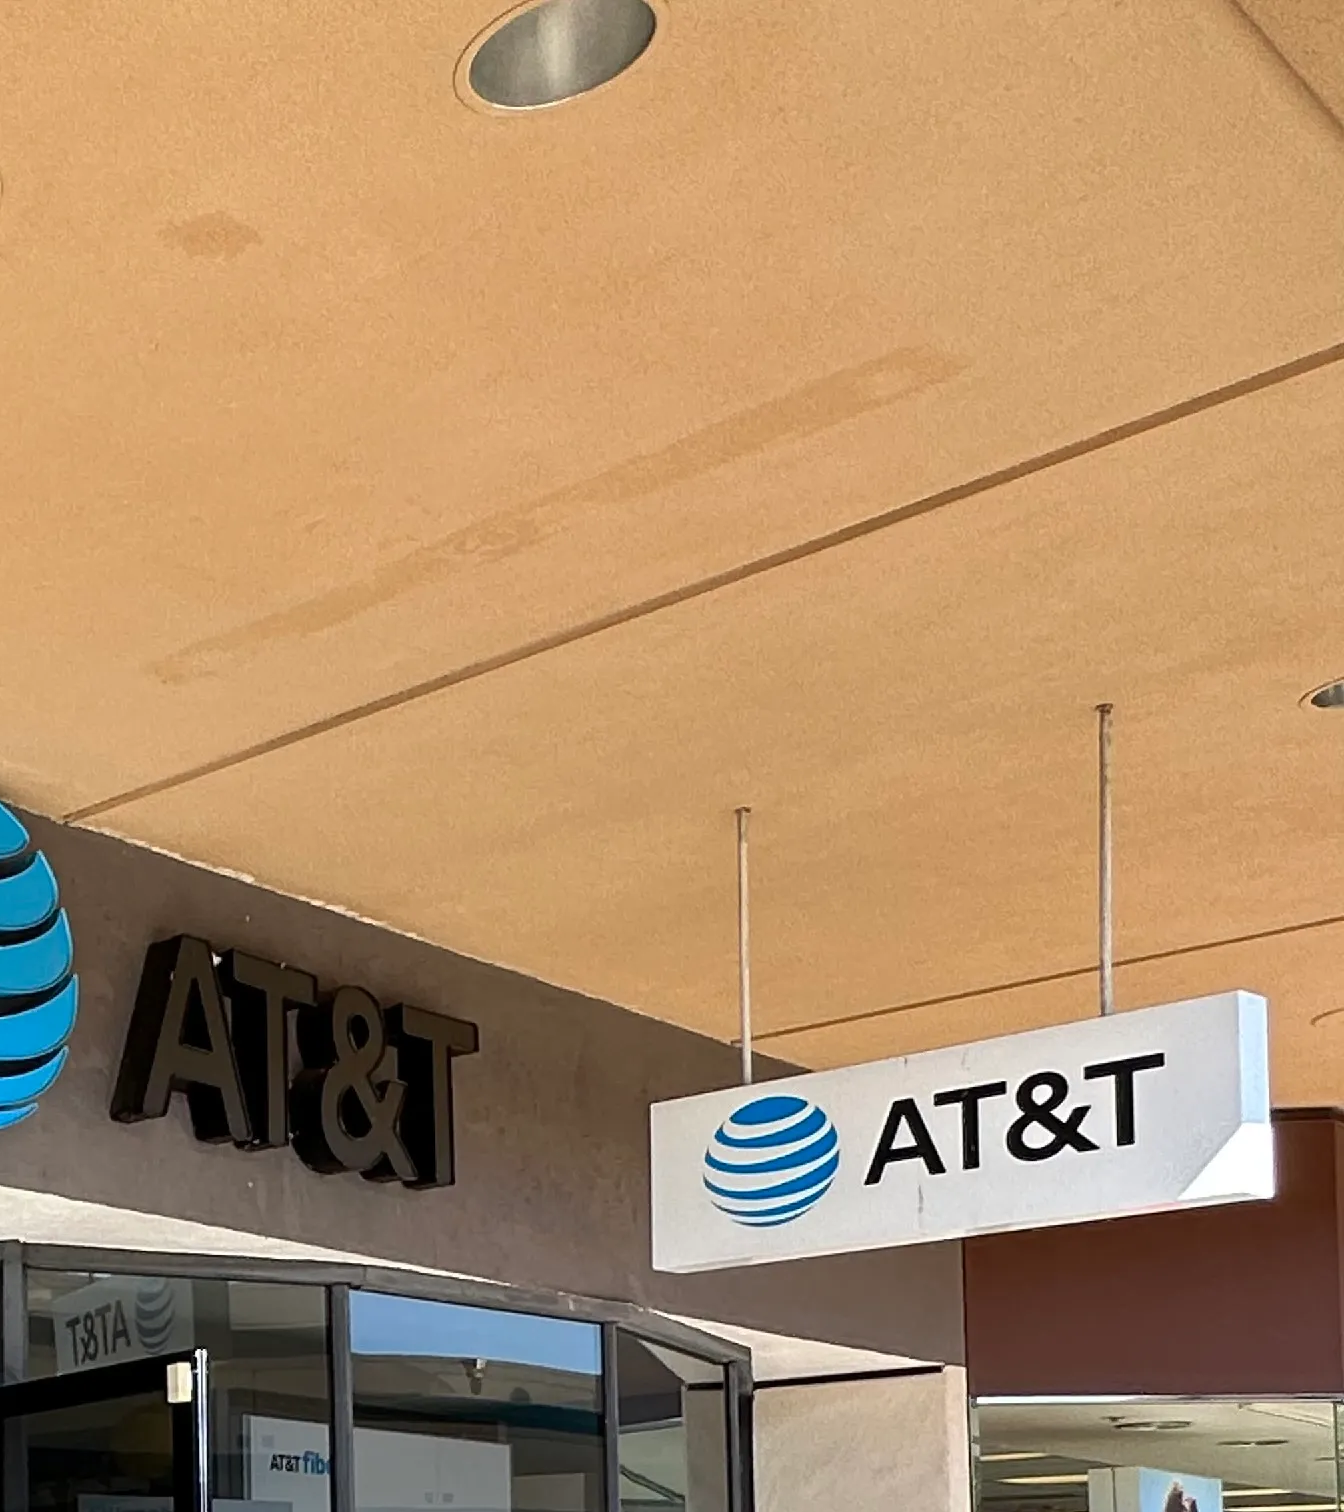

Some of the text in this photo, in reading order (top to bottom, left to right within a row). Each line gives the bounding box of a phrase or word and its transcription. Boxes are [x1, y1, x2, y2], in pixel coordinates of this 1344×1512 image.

[110, 933, 479, 1190] AT&T
[864, 1052, 1165, 1187] AT&T
[270, 1450, 331, 1476] AT&T fib
